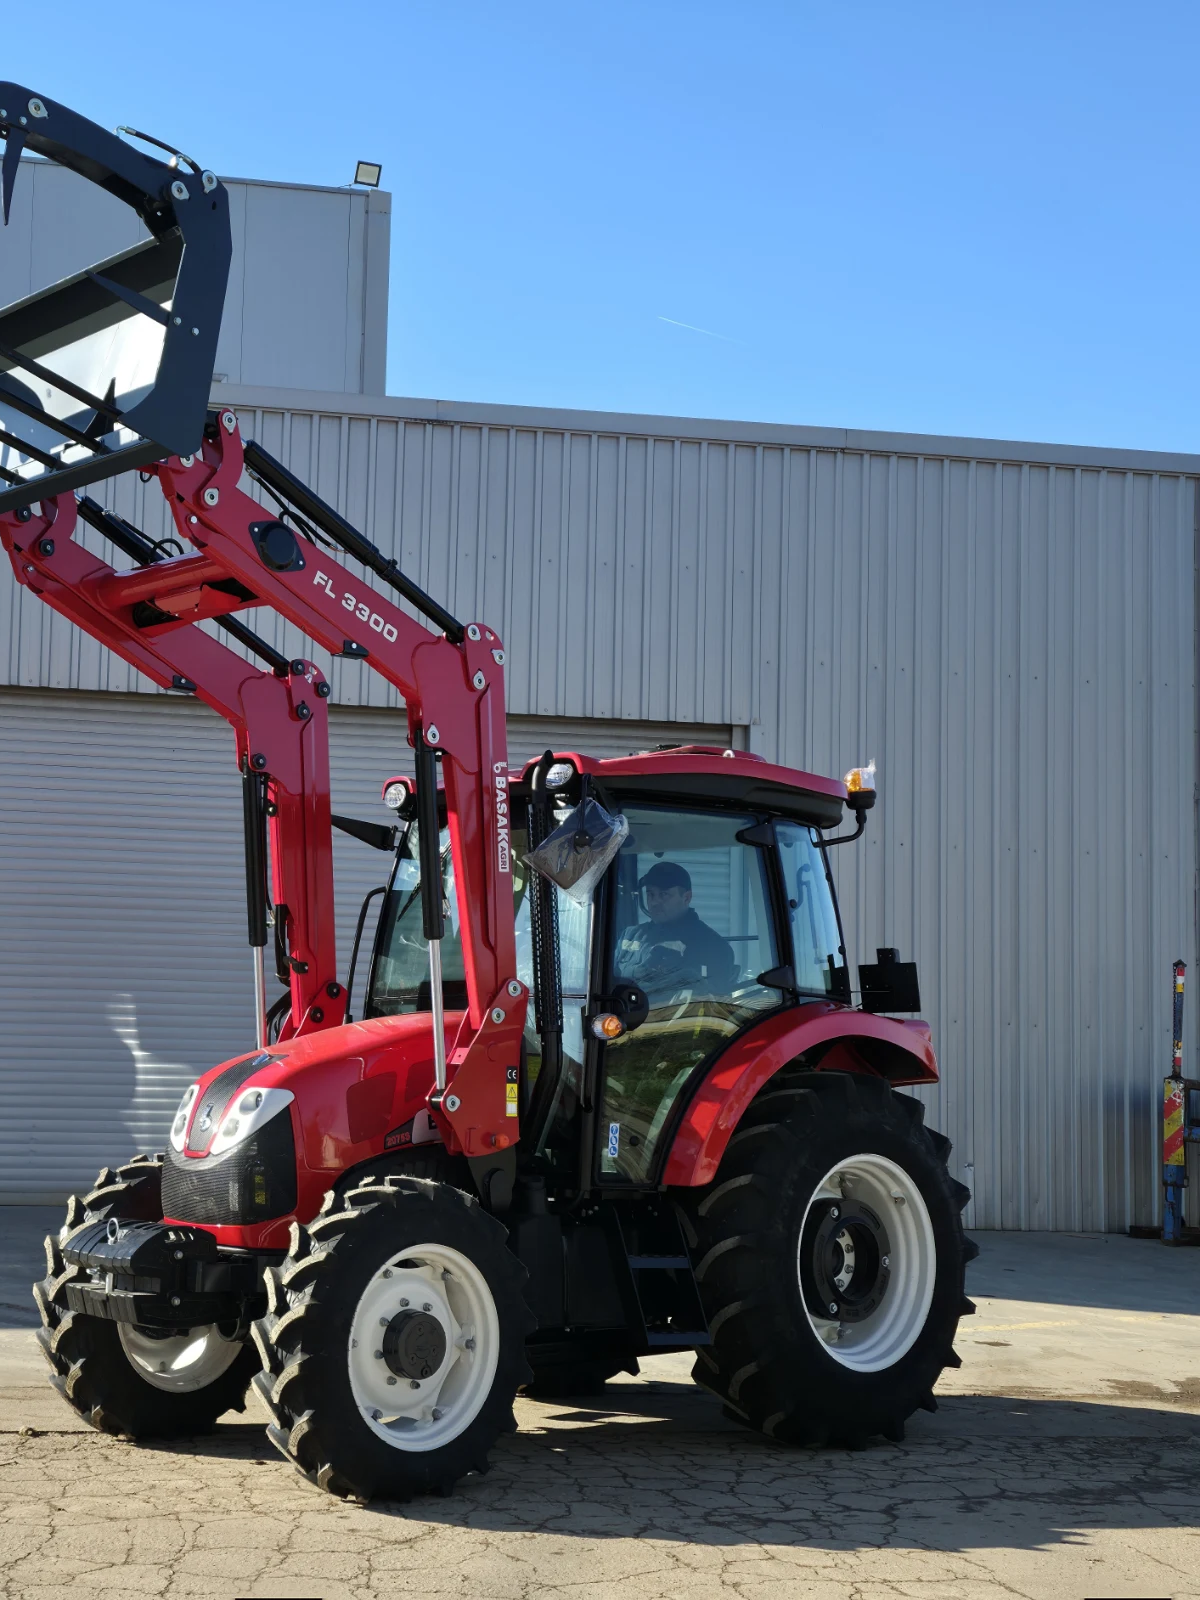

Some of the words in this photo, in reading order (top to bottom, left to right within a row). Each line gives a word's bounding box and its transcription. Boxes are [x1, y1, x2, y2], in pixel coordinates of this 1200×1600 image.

[313, 570, 336, 599] FL
[341, 592, 398, 643] 3300
[500, 845, 508, 870] AGRI
[507, 1069, 517, 1080] CE
